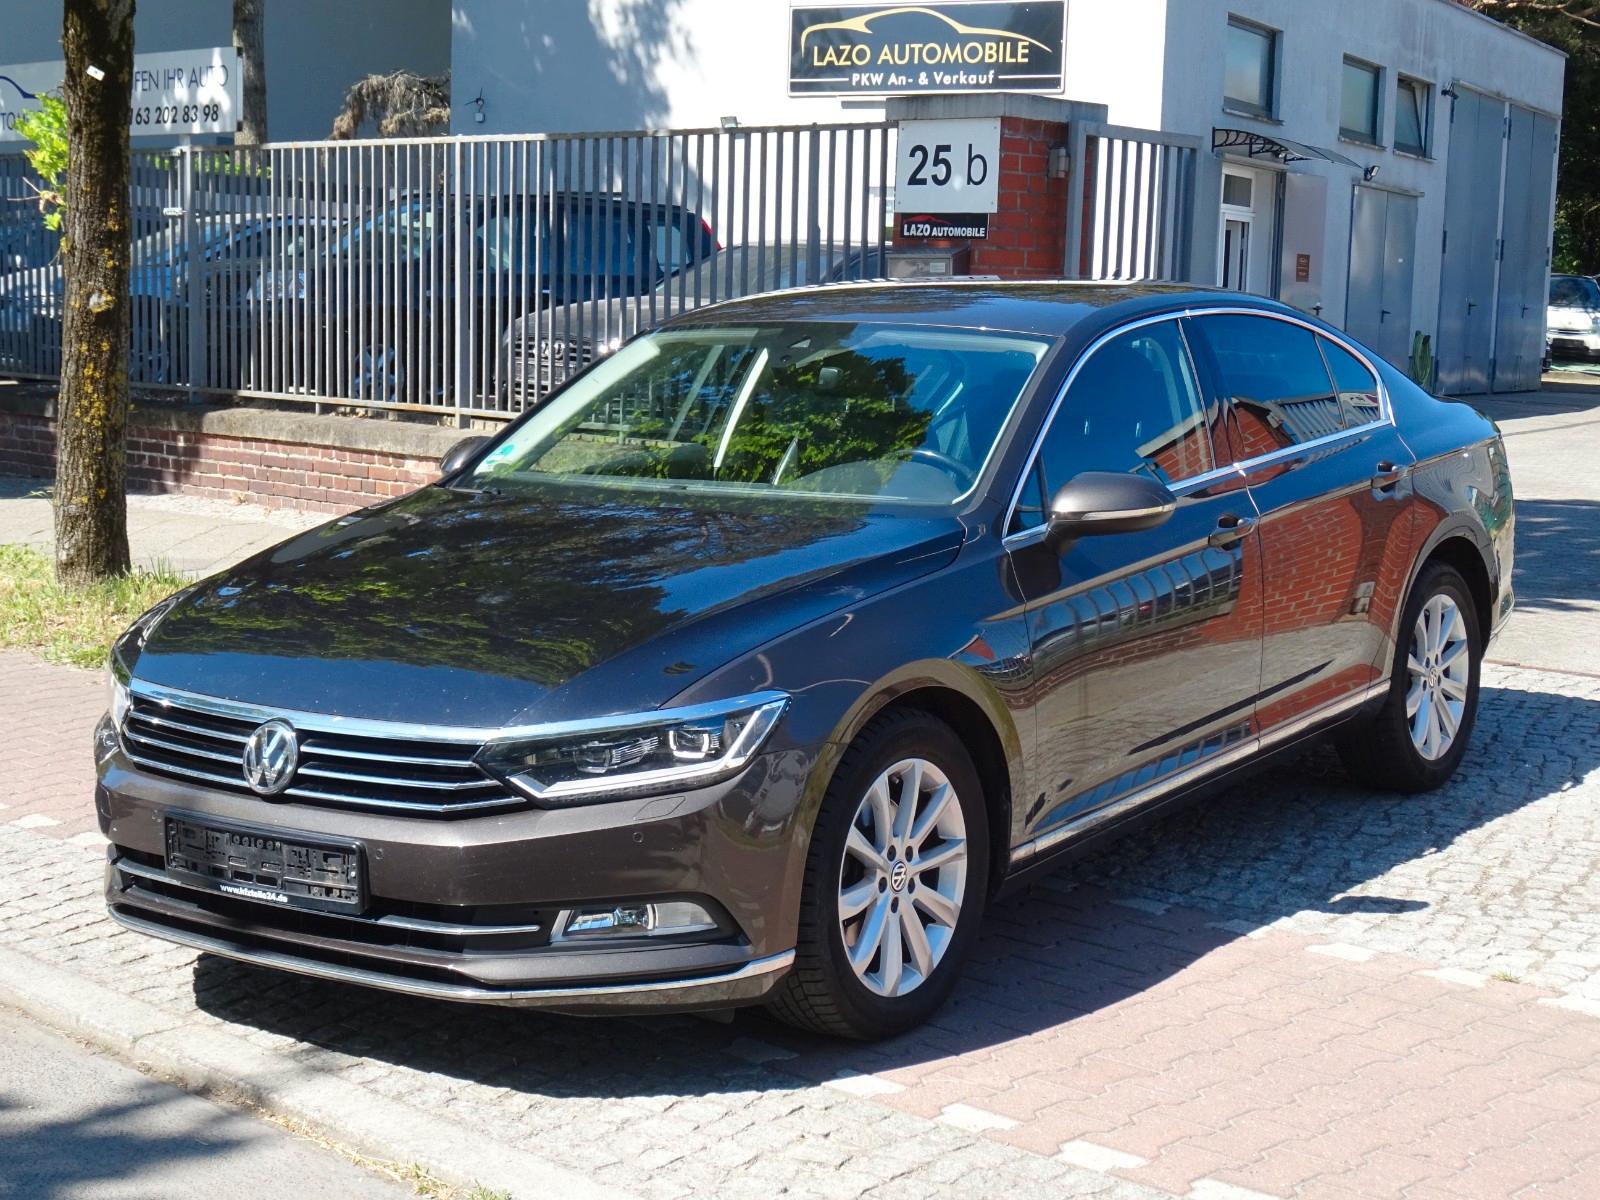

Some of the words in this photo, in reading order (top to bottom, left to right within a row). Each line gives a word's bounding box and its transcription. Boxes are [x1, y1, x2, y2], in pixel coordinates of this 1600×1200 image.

[813, 45, 871, 67] LAZO
[877, 41, 1030, 65] AUTOMOBILE
[163, 67, 184, 90] IHR
[852, 73, 883, 86] PKW
[888, 72, 913, 86] An-
[918, 72, 929, 85] &
[934, 70, 995, 85] Verkauf
[154, 105, 178, 124] 202
[182, 104, 199, 124] 83
[203, 103, 220, 122] 98
[907, 144, 952, 186] 25
[966, 143, 988, 186] b
[903, 223, 931, 236] LAZO
[931, 226, 986, 237] AUTOMOBILE
